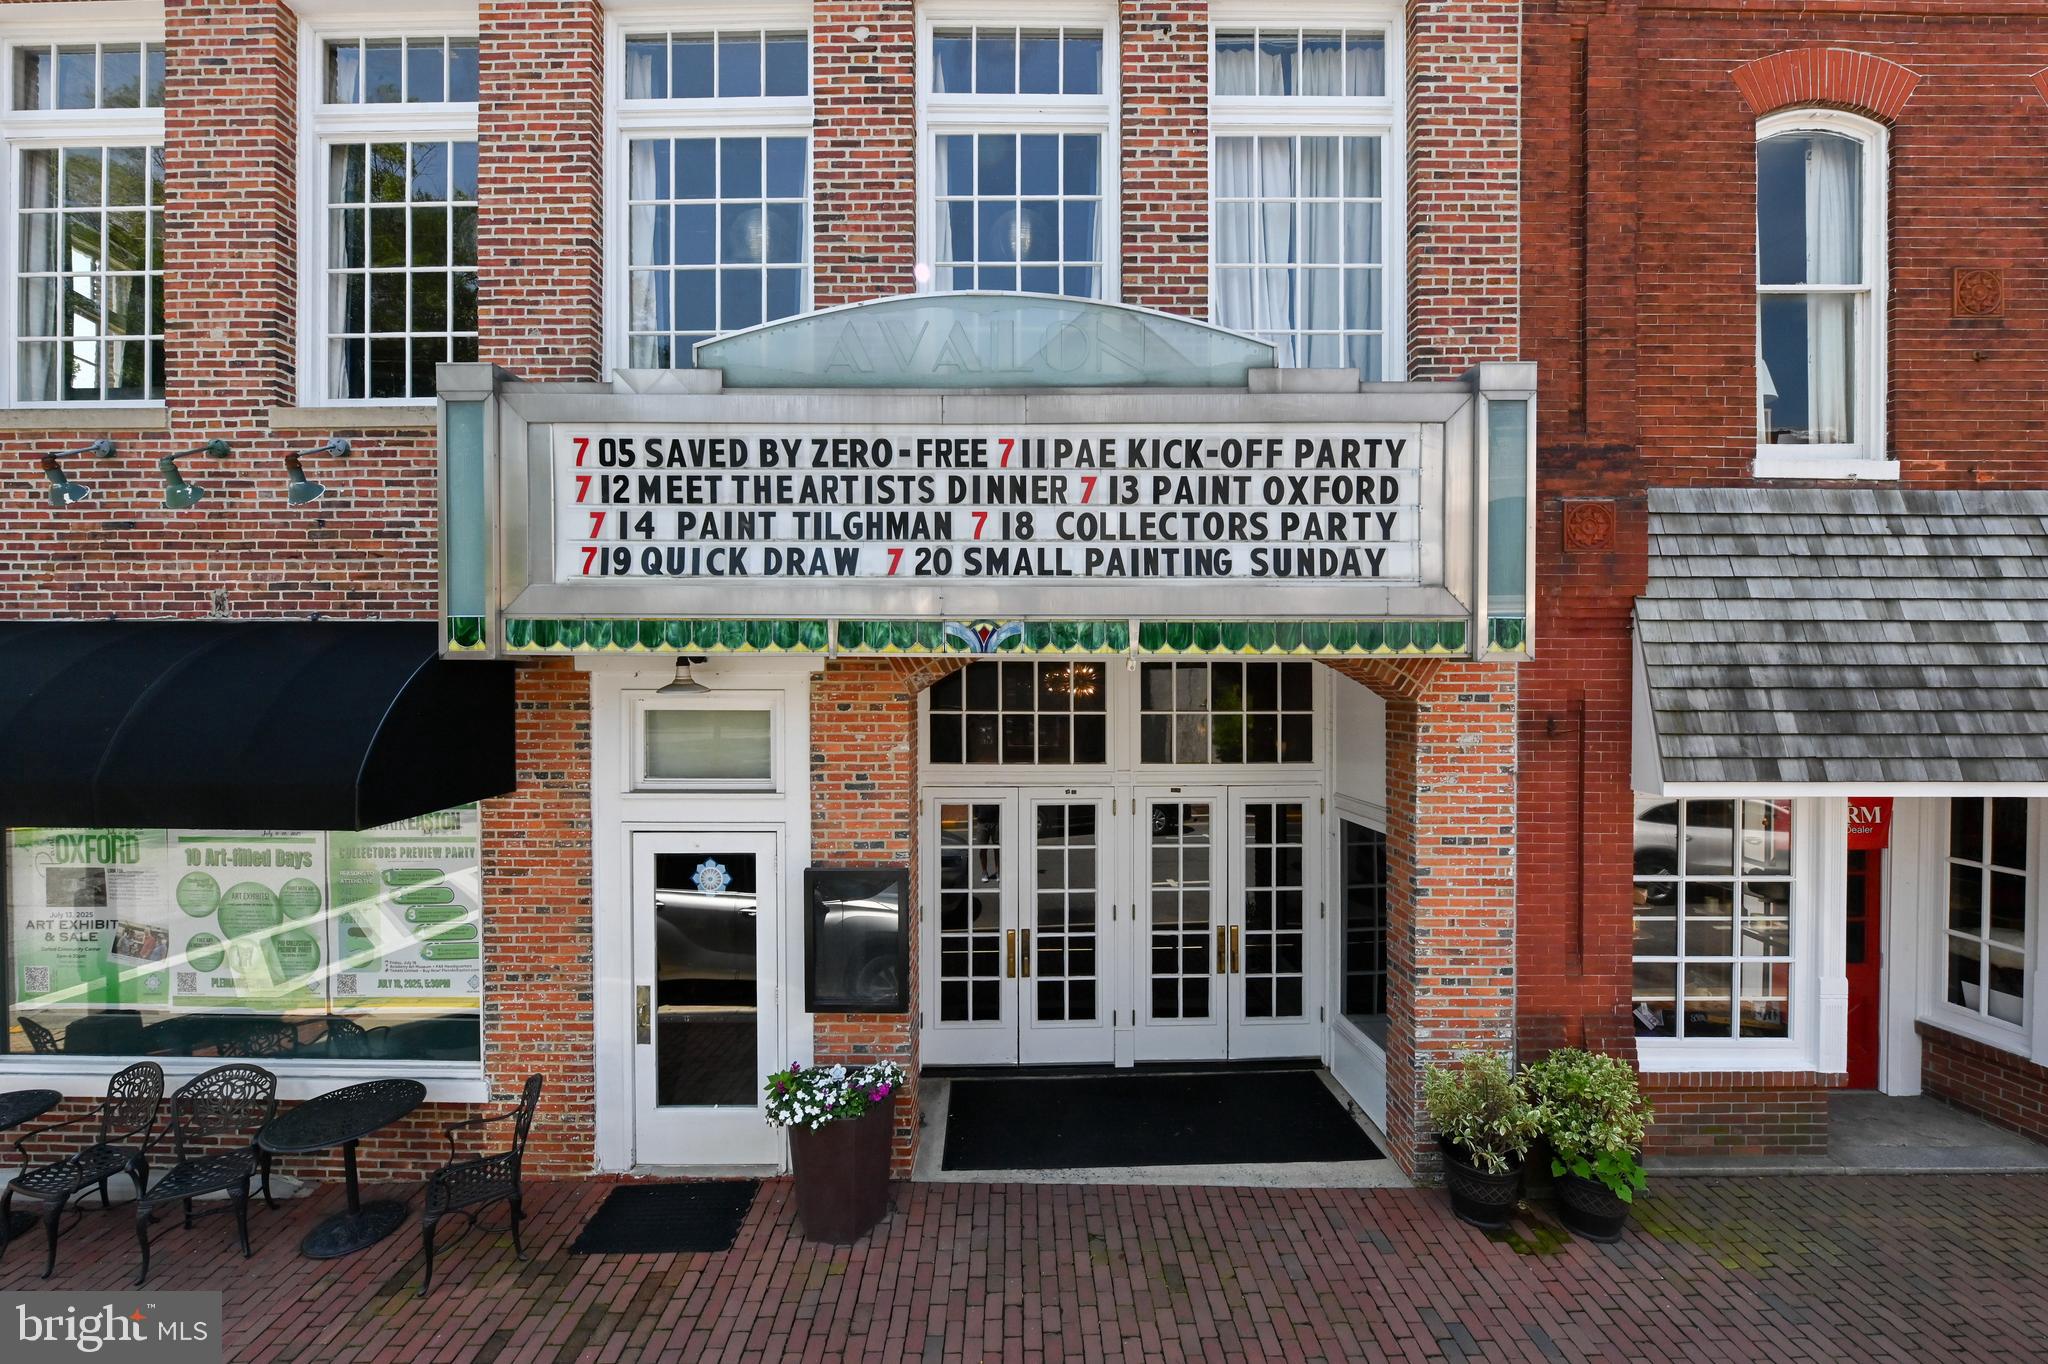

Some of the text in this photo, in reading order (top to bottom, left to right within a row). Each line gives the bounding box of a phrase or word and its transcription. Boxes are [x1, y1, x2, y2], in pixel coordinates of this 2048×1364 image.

[823, 319, 1149, 374] AVALON
[573, 437, 590, 469] 7
[598, 437, 636, 469] 05
[644, 437, 748, 469] SAVED
[759, 437, 803, 469] BY
[998, 437, 1015, 469] 7
[1054, 437, 1116, 469] PAE
[1128, 437, 1283, 469] KICK-OFF
[1294, 437, 1407, 469] PARTY
[575, 475, 592, 505] 7
[600, 475, 630, 505] 12
[638, 475, 723, 505] MEET
[948, 475, 1068, 505] DINNER
[1080, 475, 1097, 505] 7
[1109, 475, 1140, 505] 13
[1152, 475, 1252, 505] PAINT
[1262, 475, 1399, 505] OXFORD
[589, 510, 1398, 541] 7 14 PAINT TILGHMAN 7 18 COLLECTORS PARTY
[581, 546, 1387, 577] 7 19 QUICK DRAW 7 20 SMALL PAINTING SUNDAY
[55, 834, 140, 864] OXFORD
[185, 848, 202, 867] 10
[275, 848, 313, 870] Days
[339, 846, 476, 859] COLLECTORS PREVIEW PARTY
[26, 919, 119, 930] ART EXHIBIT
[408, 909, 417, 920] 3
[44, 932, 99, 942] & SALE
